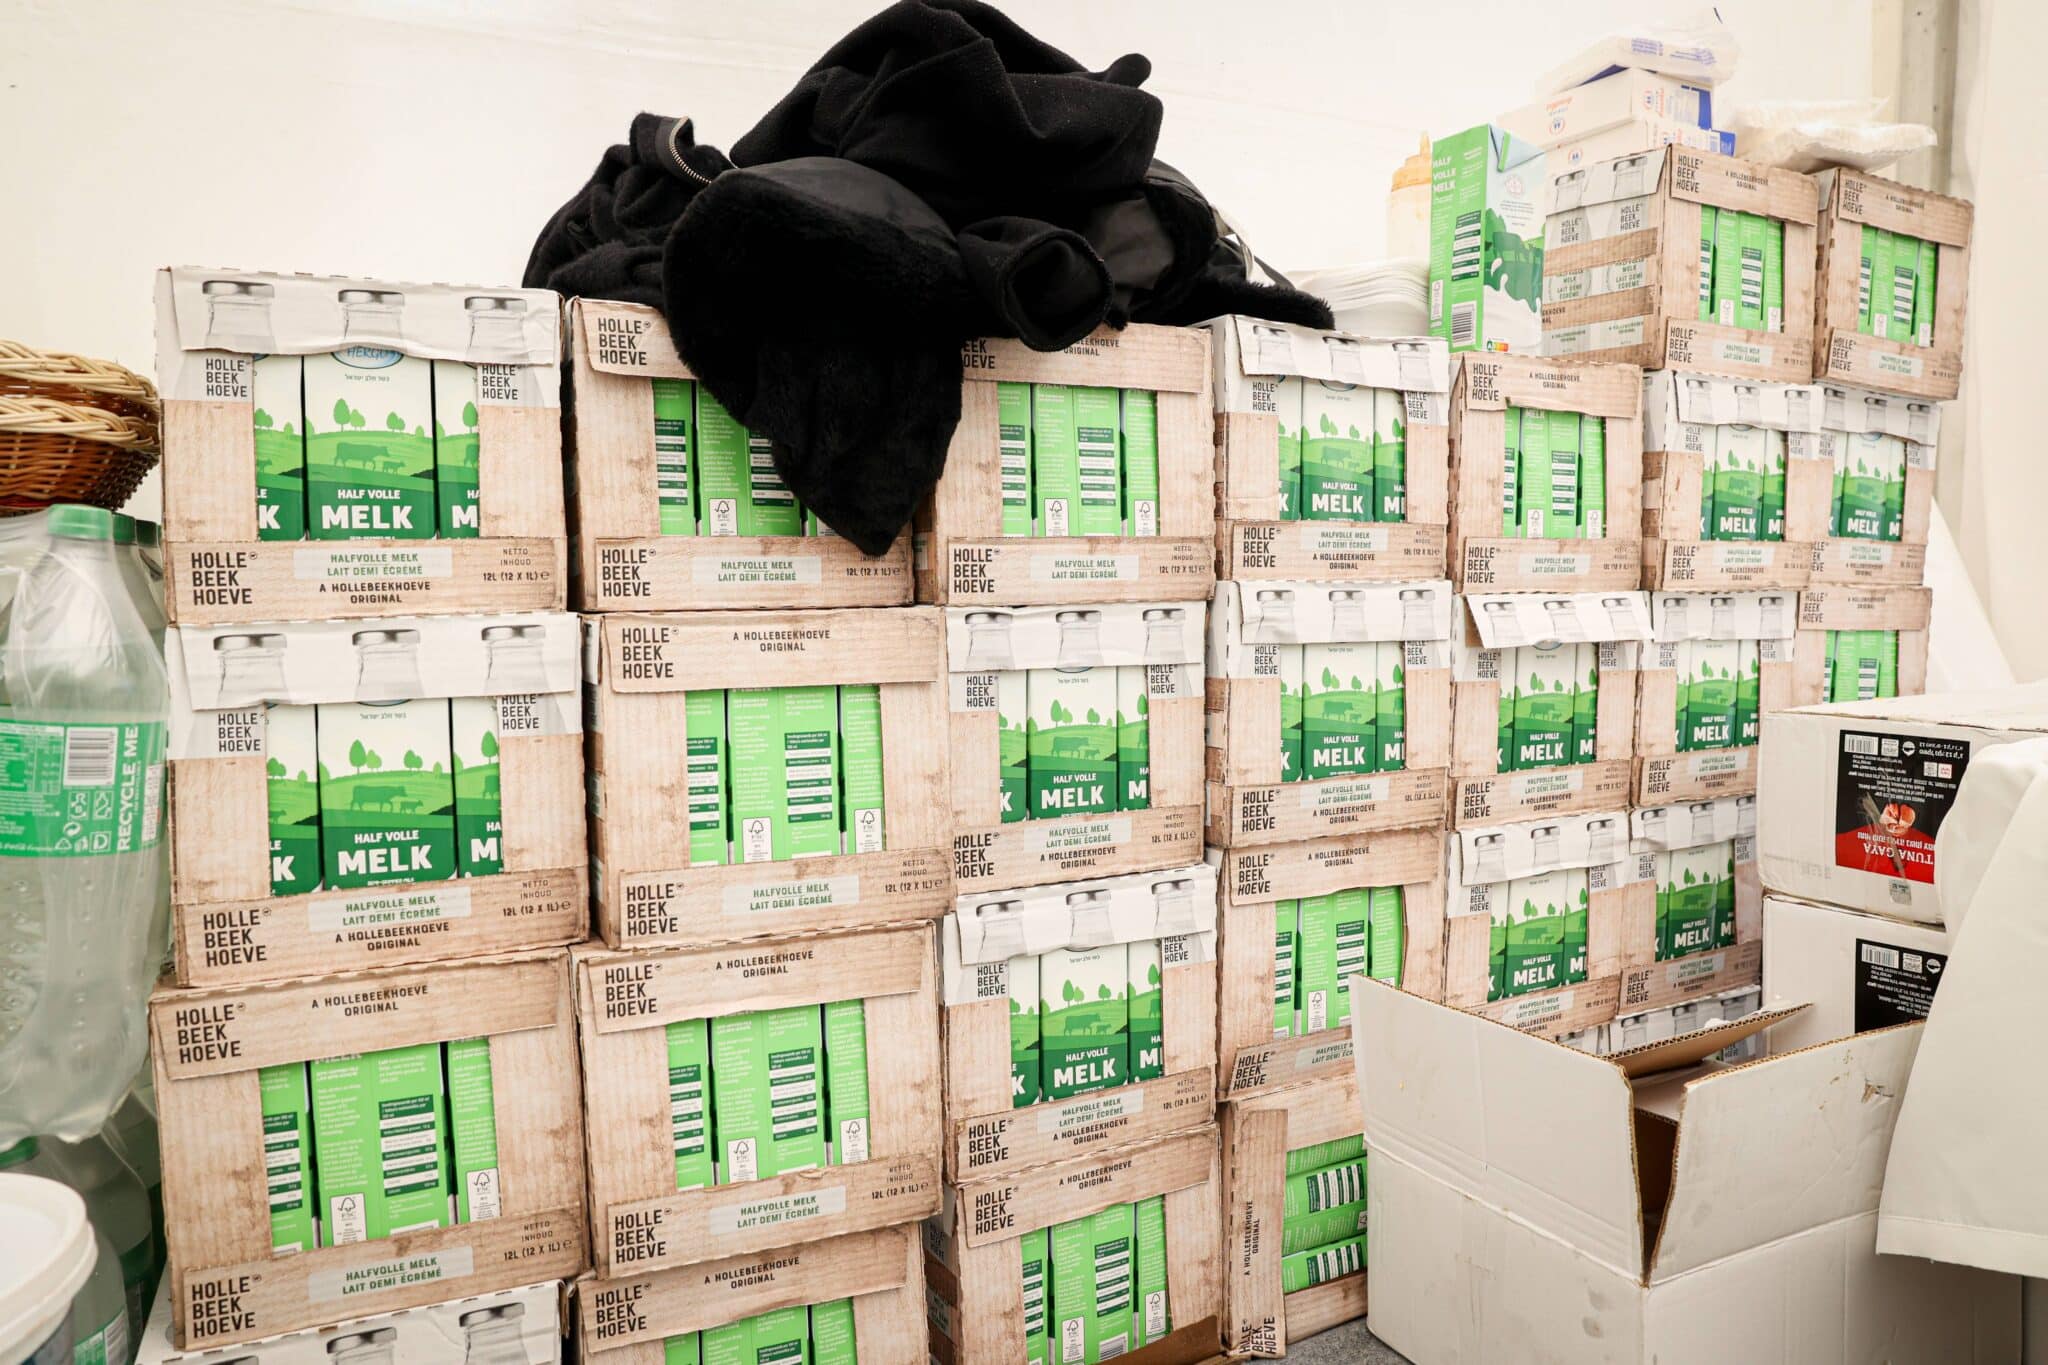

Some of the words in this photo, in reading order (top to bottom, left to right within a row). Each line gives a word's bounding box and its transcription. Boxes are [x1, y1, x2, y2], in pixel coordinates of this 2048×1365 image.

[1678, 155, 1699, 169] HOLLE
[1433, 168, 1456, 180] VOLLE
[1677, 166, 1694, 179] BEEK
[1676, 179, 1699, 193] HOEVE
[598, 318, 643, 334] HOLLE
[1671, 327, 1693, 339] HOLLE
[600, 334, 636, 349] BEEK
[1670, 339, 1688, 350] BEEK
[1834, 338, 1852, 350] HOLLE
[600, 350, 647, 365] HOEVE
[1669, 351, 1692, 363] HOEVE
[1833, 348, 1847, 357] BEEK
[206, 358, 244, 371] HOLLE
[1473, 363, 1497, 376] HOLLE
[1832, 360, 1851, 371] HOEVE
[206, 372, 238, 384] BEEK
[1474, 376, 1493, 388] BEEK
[207, 384, 247, 397] HOEVE
[1472, 389, 1499, 401] HOEVE
[338, 489, 366, 499] HALF
[368, 490, 400, 499] VOLLE
[1312, 494, 1363, 513] MELK
[322, 505, 413, 529] MELK
[1720, 517, 1756, 534] MELK
[1847, 518, 1879, 536] MELK
[1244, 527, 1275, 540] HOLLE
[1244, 541, 1269, 553] BEEK
[1469, 547, 1495, 558] HOLLE
[1673, 546, 1696, 556] HOLLE
[192, 552, 247, 568] HOLLE
[331, 554, 386, 563] HALFVOLLE
[392, 553, 418, 562] MELK
[501, 558, 531, 566] INHOUD
[602, 549, 647, 564] HOLLE
[954, 549, 992, 562] HOLLE
[1243, 555, 1276, 567] HOEVE
[1673, 558, 1691, 568] BEEK
[328, 568, 349, 576] LAIT
[353, 567, 378, 575] DEMI
[954, 564, 986, 578] BEEK
[1468, 559, 1489, 570] BEEK
[192, 570, 239, 587] BEEK
[603, 566, 640, 580] BEEK
[1467, 572, 1495, 583] HOEVE
[1672, 569, 1695, 580] HOEVE
[320, 584, 326, 592] A
[332, 582, 430, 592] HOLLEBEEKHOEVE
[603, 582, 650, 597] HOEVE
[954, 579, 994, 593] HOEVE
[193, 588, 252, 605] HOEVE
[350, 594, 402, 603] ORIGINAL
[1805, 592, 1824, 602] HOLLE
[1804, 603, 1820, 612] BEEK
[1803, 613, 1823, 623] HOEVE
[622, 628, 669, 643] HOLLE
[733, 632, 739, 640] A
[744, 630, 830, 640] HOLLEBEEKHOEVE
[623, 645, 662, 661] BEEK
[760, 642, 805, 652] ORIGINAL
[623, 663, 673, 679] HOEVE
[1694, 724, 1729, 742] MELK
[124, 726, 139, 757] ME
[1314, 747, 1365, 767] MELK
[1521, 743, 1563, 761] MELK
[1649, 760, 1671, 771] HOLLE
[1053, 775, 1072, 784] HALF
[1074, 773, 1096, 782] VOLLE
[1649, 772, 1666, 783] BEEK
[1465, 782, 1490, 795] HOLLE
[1648, 782, 1670, 793] HOEVE
[1042, 785, 1104, 809] MELK
[1243, 790, 1274, 804] HOLLE
[1464, 795, 1485, 807] BEEK
[117, 762, 136, 850] RECYCLE
[1243, 804, 1268, 818] BEEK
[1464, 806, 1490, 819] HOEVE
[1242, 817, 1275, 832] HOEVE
[355, 832, 383, 844] HALF
[385, 830, 419, 841] VOLLE
[954, 833, 992, 849] HOLLE
[954, 848, 985, 864] BEEK
[1863, 841, 1895, 858] GAYA
[1899, 848, 1934, 865] TUNA
[338, 845, 432, 875] MELK
[1239, 854, 1269, 869] HOLLE
[955, 862, 994, 879] HOEVE
[1239, 869, 1264, 883] BEEK
[627, 884, 674, 901] HOLLE
[1238, 881, 1270, 896] HOEVE
[627, 902, 667, 919] BEEK
[204, 909, 260, 930] HOLLE
[628, 917, 678, 936] HOEVE
[205, 928, 252, 948] BEEK
[336, 934, 342, 943] A
[348, 922, 449, 941] HOLLEBEEKHOEVE
[1675, 928, 1709, 948] MELK
[368, 938, 420, 951] ORIGINAL
[206, 945, 267, 967] HOEVE
[606, 965, 653, 984] HOLLE
[1514, 964, 1555, 986] MELK
[1628, 970, 1649, 984] HOLLE
[606, 983, 646, 1002] BEEK
[1627, 982, 1644, 995] BEEK
[312, 1000, 318, 1008] A
[325, 985, 427, 1009] HOLLEBEEKHOEVE
[1626, 991, 1648, 1005] HOEVE
[176, 1004, 234, 1027] HOLLE
[345, 1002, 398, 1016] ORIGINAL
[607, 998, 657, 1018] HOEVE
[178, 1024, 226, 1045] BEEK
[179, 1041, 241, 1064] HOEVE
[1066, 1052, 1085, 1062] HALF
[1087, 1047, 1108, 1058] VOLLE
[1238, 1052, 1269, 1068] HOLLE
[1054, 1060, 1115, 1089] MELK
[1236, 1065, 1261, 1079] BEEK
[1233, 1071, 1266, 1090] HOEVE
[969, 1120, 1006, 1139] HOLLE
[969, 1135, 1000, 1153] BEEK
[969, 1145, 1008, 1168] HOEVE
[976, 1188, 1011, 1211] HOLLE
[615, 1210, 662, 1231] HOLLE
[976, 1203, 1006, 1224] BEEK
[976, 1214, 1014, 1235] HOEVE
[616, 1227, 655, 1247] BEEK
[616, 1241, 666, 1264] HOEVE
[346, 1263, 406, 1283] HALFVOLLE
[410, 1258, 437, 1269] MELK
[705, 1276, 710, 1284] A
[714, 1256, 800, 1283] HOLLEBEEKHOEVE
[343, 1283, 365, 1294] LAIT
[370, 1277, 395, 1289] DEMI
[731, 1271, 775, 1288] ORIGINAL
[192, 1276, 250, 1301] HOLLE
[596, 1286, 642, 1311] HOLLE
[193, 1296, 241, 1320] BEEK
[597, 1302, 635, 1324] BEEK
[193, 1311, 255, 1338] HOEVE
[597, 1314, 646, 1339] HOEVE
[1251, 1327, 1263, 1353] BEEK
[1264, 1316, 1276, 1354] HOEVE
